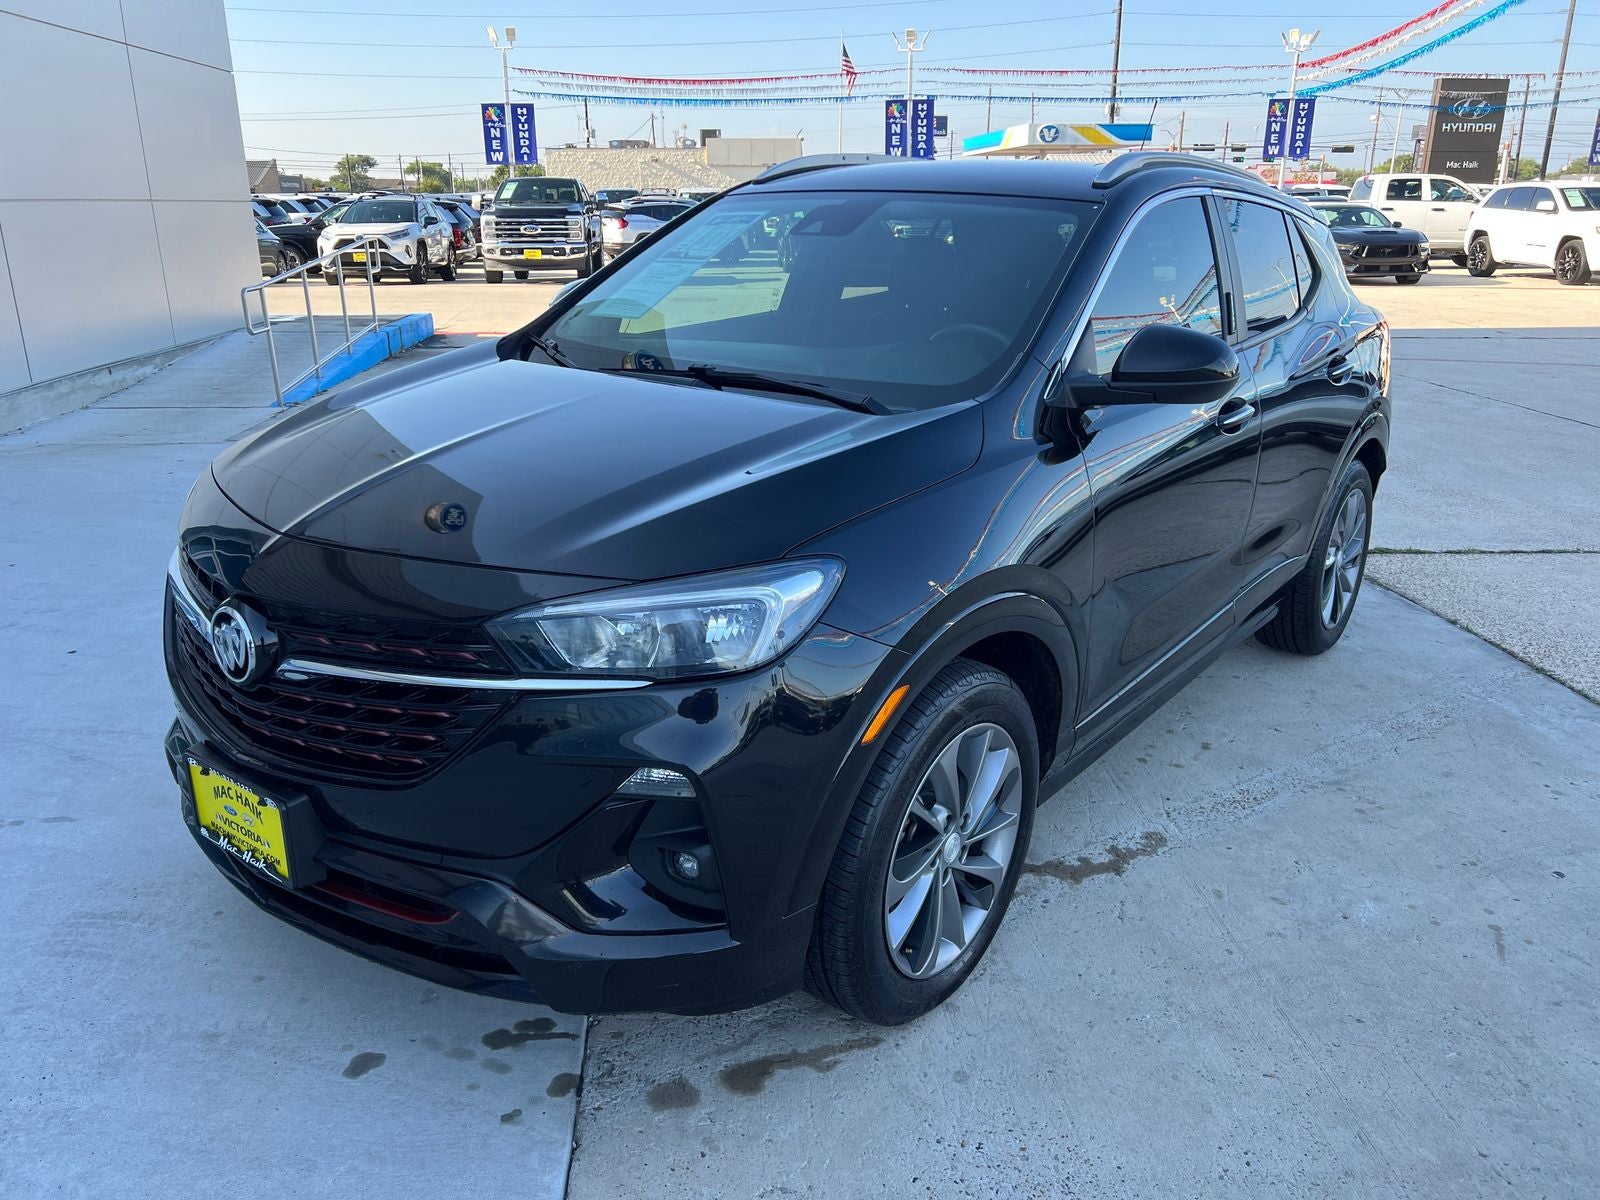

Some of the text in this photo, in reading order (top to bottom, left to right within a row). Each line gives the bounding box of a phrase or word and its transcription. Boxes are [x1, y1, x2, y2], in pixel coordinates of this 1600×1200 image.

[517, 108, 530, 161] HYUNDAI
[890, 124, 902, 156] NEW
[917, 103, 927, 156] HYUNDAI
[1268, 123, 1280, 154] NEW
[1295, 103, 1308, 154] HYUNDAI
[1442, 123, 1496, 132] HYUNDAI
[490, 128, 503, 161] NEW
[213, 786, 234, 800] MAC
[236, 790, 264, 825] HAIK
[221, 814, 262, 845] VICTORIA
[214, 836, 241, 857] Mac
